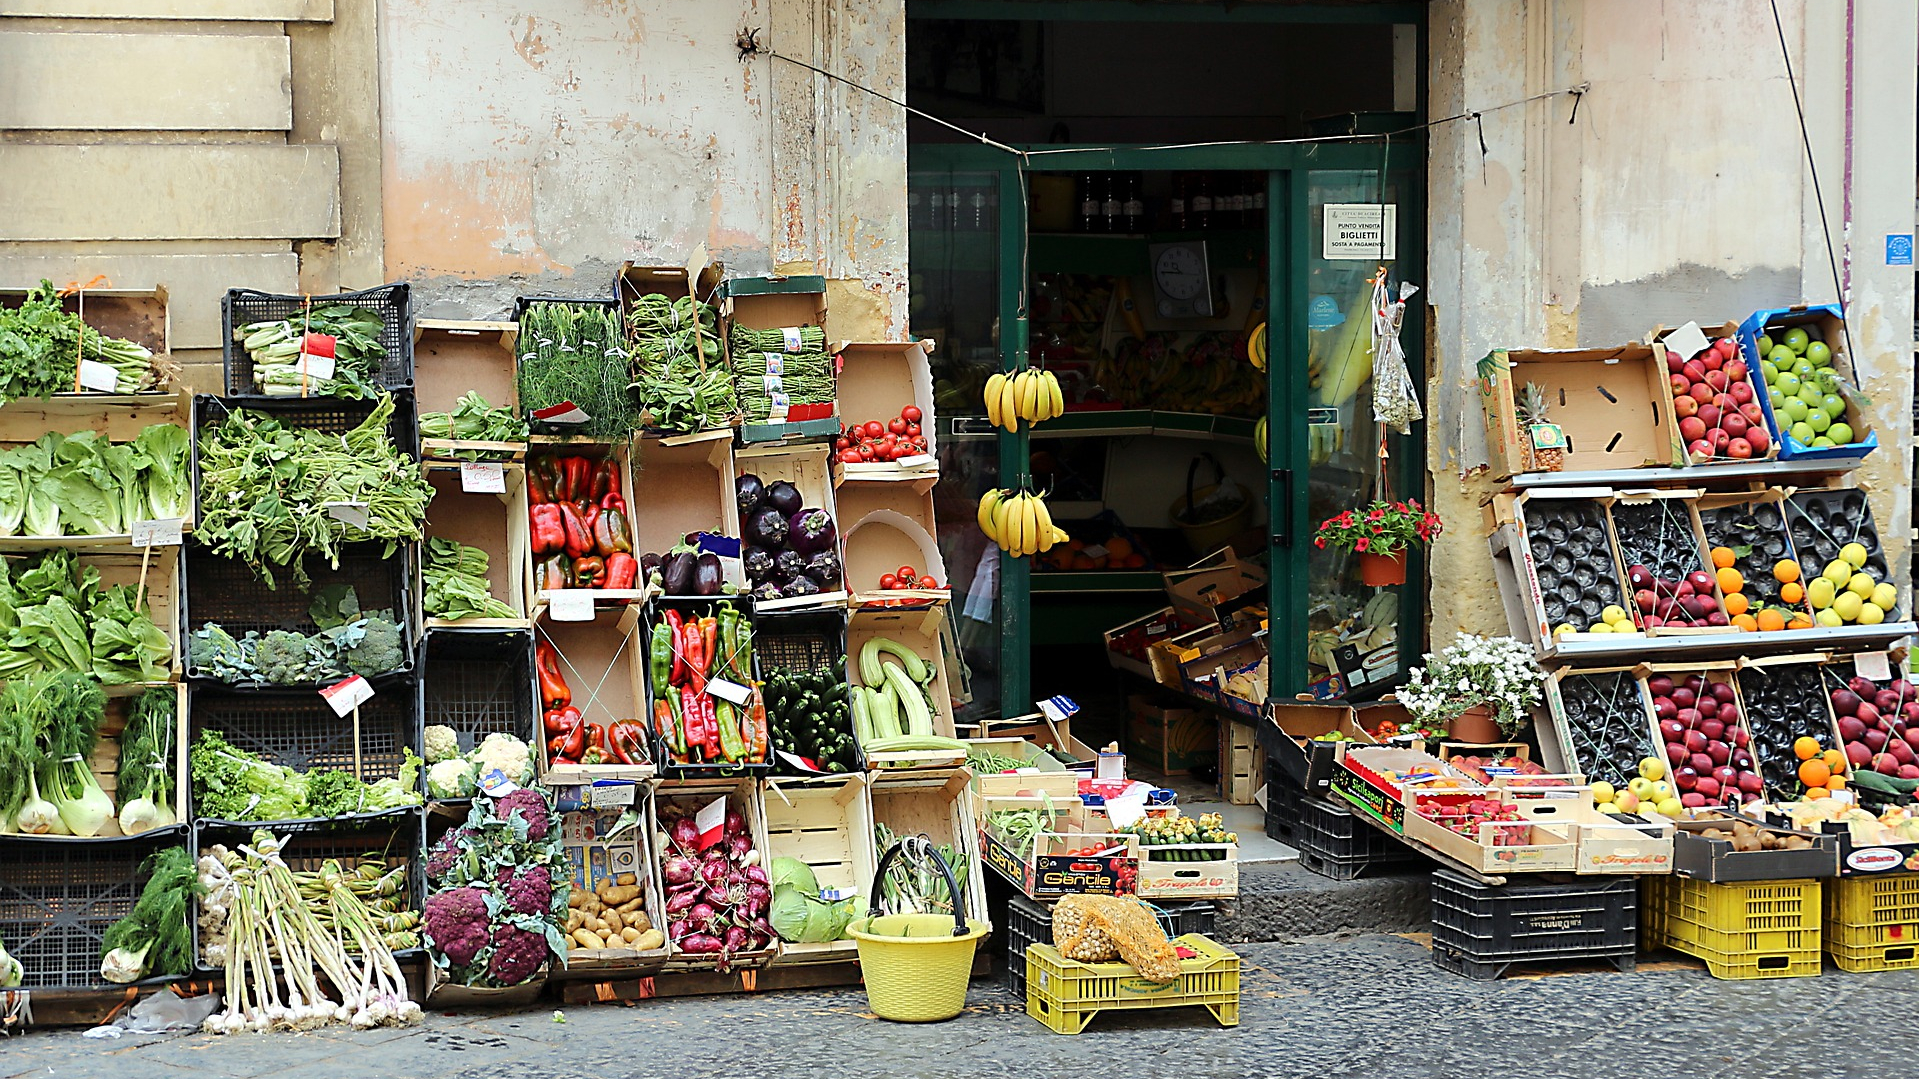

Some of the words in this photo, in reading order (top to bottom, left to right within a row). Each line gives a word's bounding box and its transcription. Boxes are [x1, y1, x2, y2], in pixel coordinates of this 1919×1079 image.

[1340, 231, 1378, 239] BIGLIETTI
[1352, 778, 1383, 809] Sicilsapori
[580, 792, 591, 810] 2.99
[990, 843, 1022, 881] Gentile
[1601, 854, 1654, 865] Fragole
[1043, 872, 1111, 886] Gentile
[1152, 878, 1208, 889] Fragole
